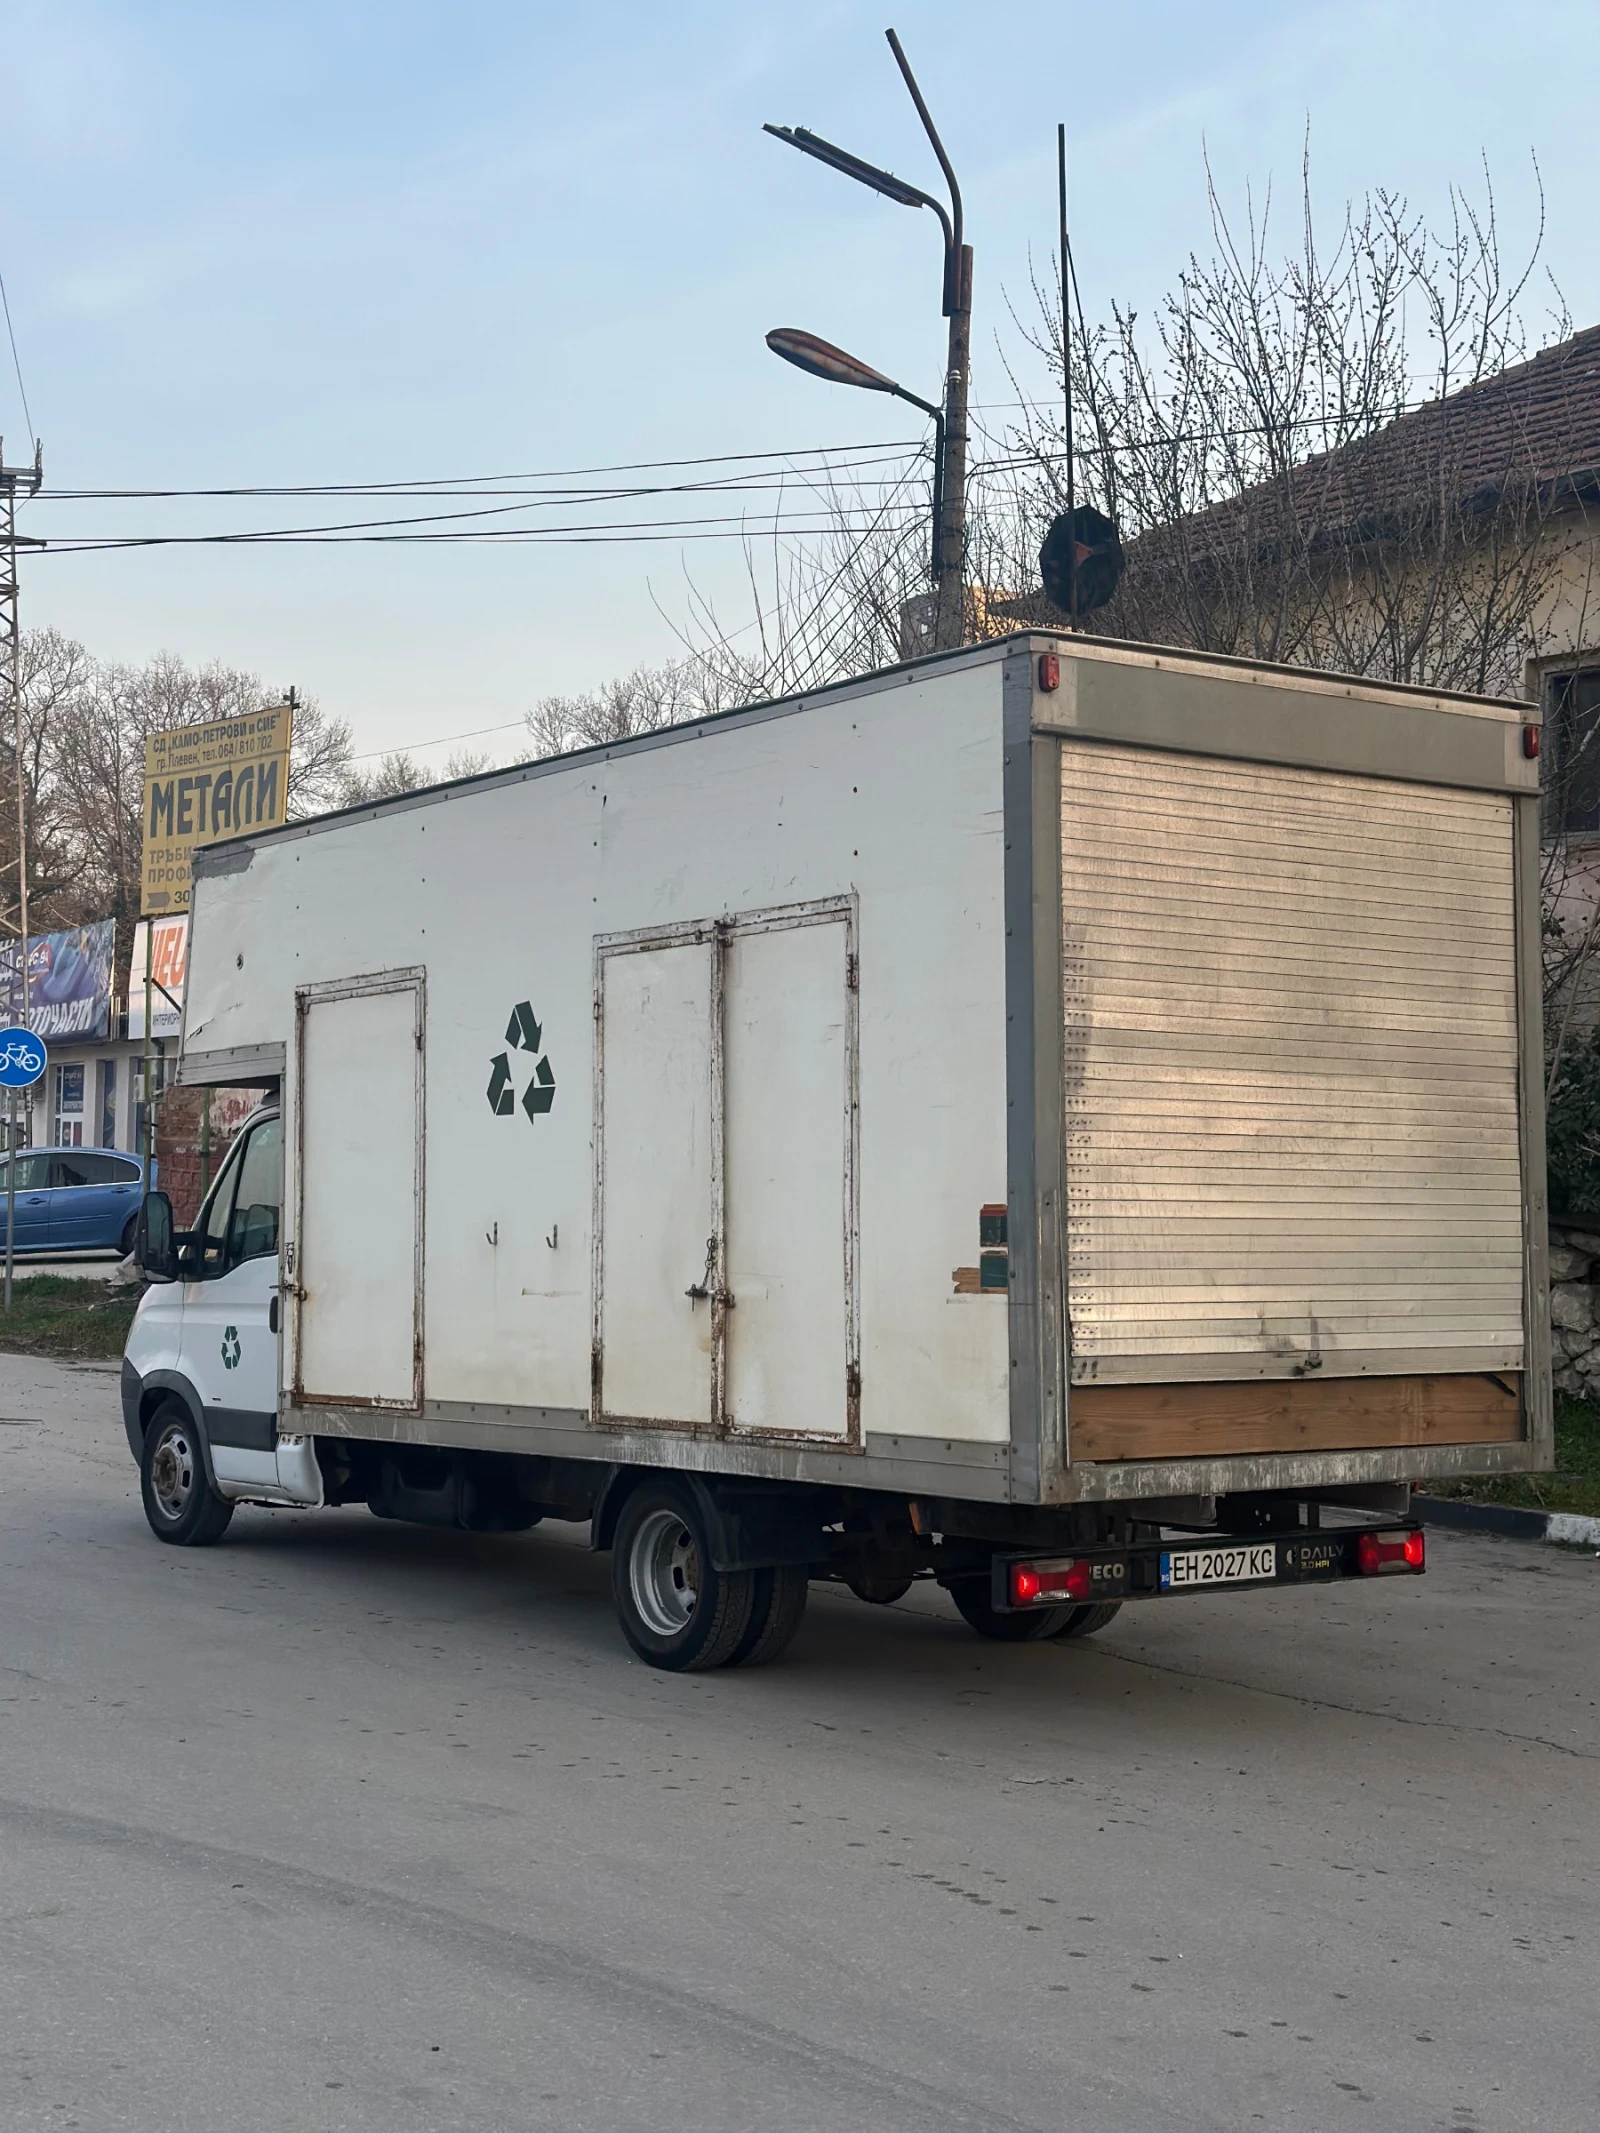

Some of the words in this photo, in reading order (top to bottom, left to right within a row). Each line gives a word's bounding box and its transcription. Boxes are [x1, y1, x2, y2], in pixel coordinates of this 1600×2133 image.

[153, 738, 166, 754] СД
[150, 760, 278, 838] МЕТАЛИ
[1089, 1562, 1125, 1579] ECO
[1173, 1555, 1199, 1581] EH
[1202, 1551, 1246, 1580] 2027
